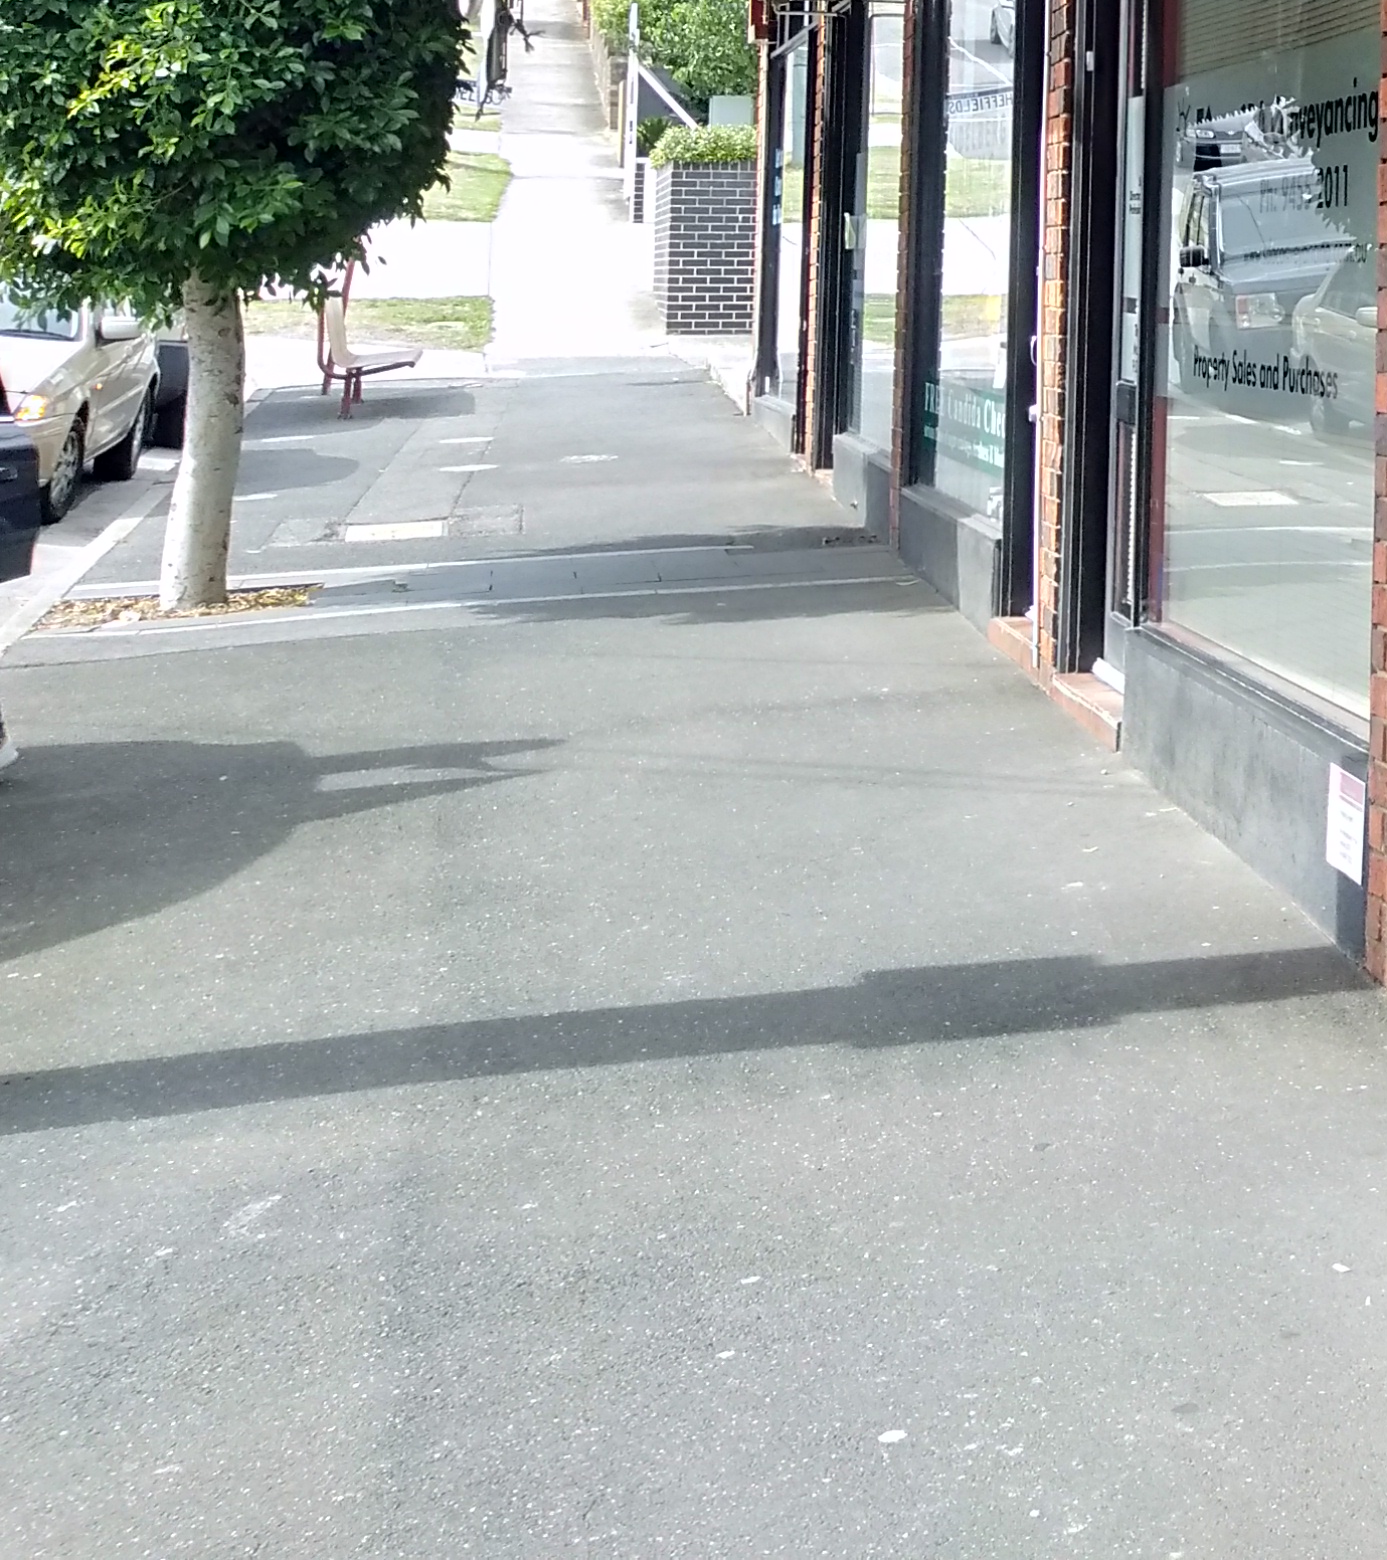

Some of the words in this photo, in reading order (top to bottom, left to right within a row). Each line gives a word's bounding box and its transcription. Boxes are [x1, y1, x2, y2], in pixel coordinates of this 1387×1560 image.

[1194, 345, 1229, 391] Property
[1232, 349, 1257, 387] Sales
[1260, 353, 1279, 390] and
[1283, 356, 1338, 399] Purchases
